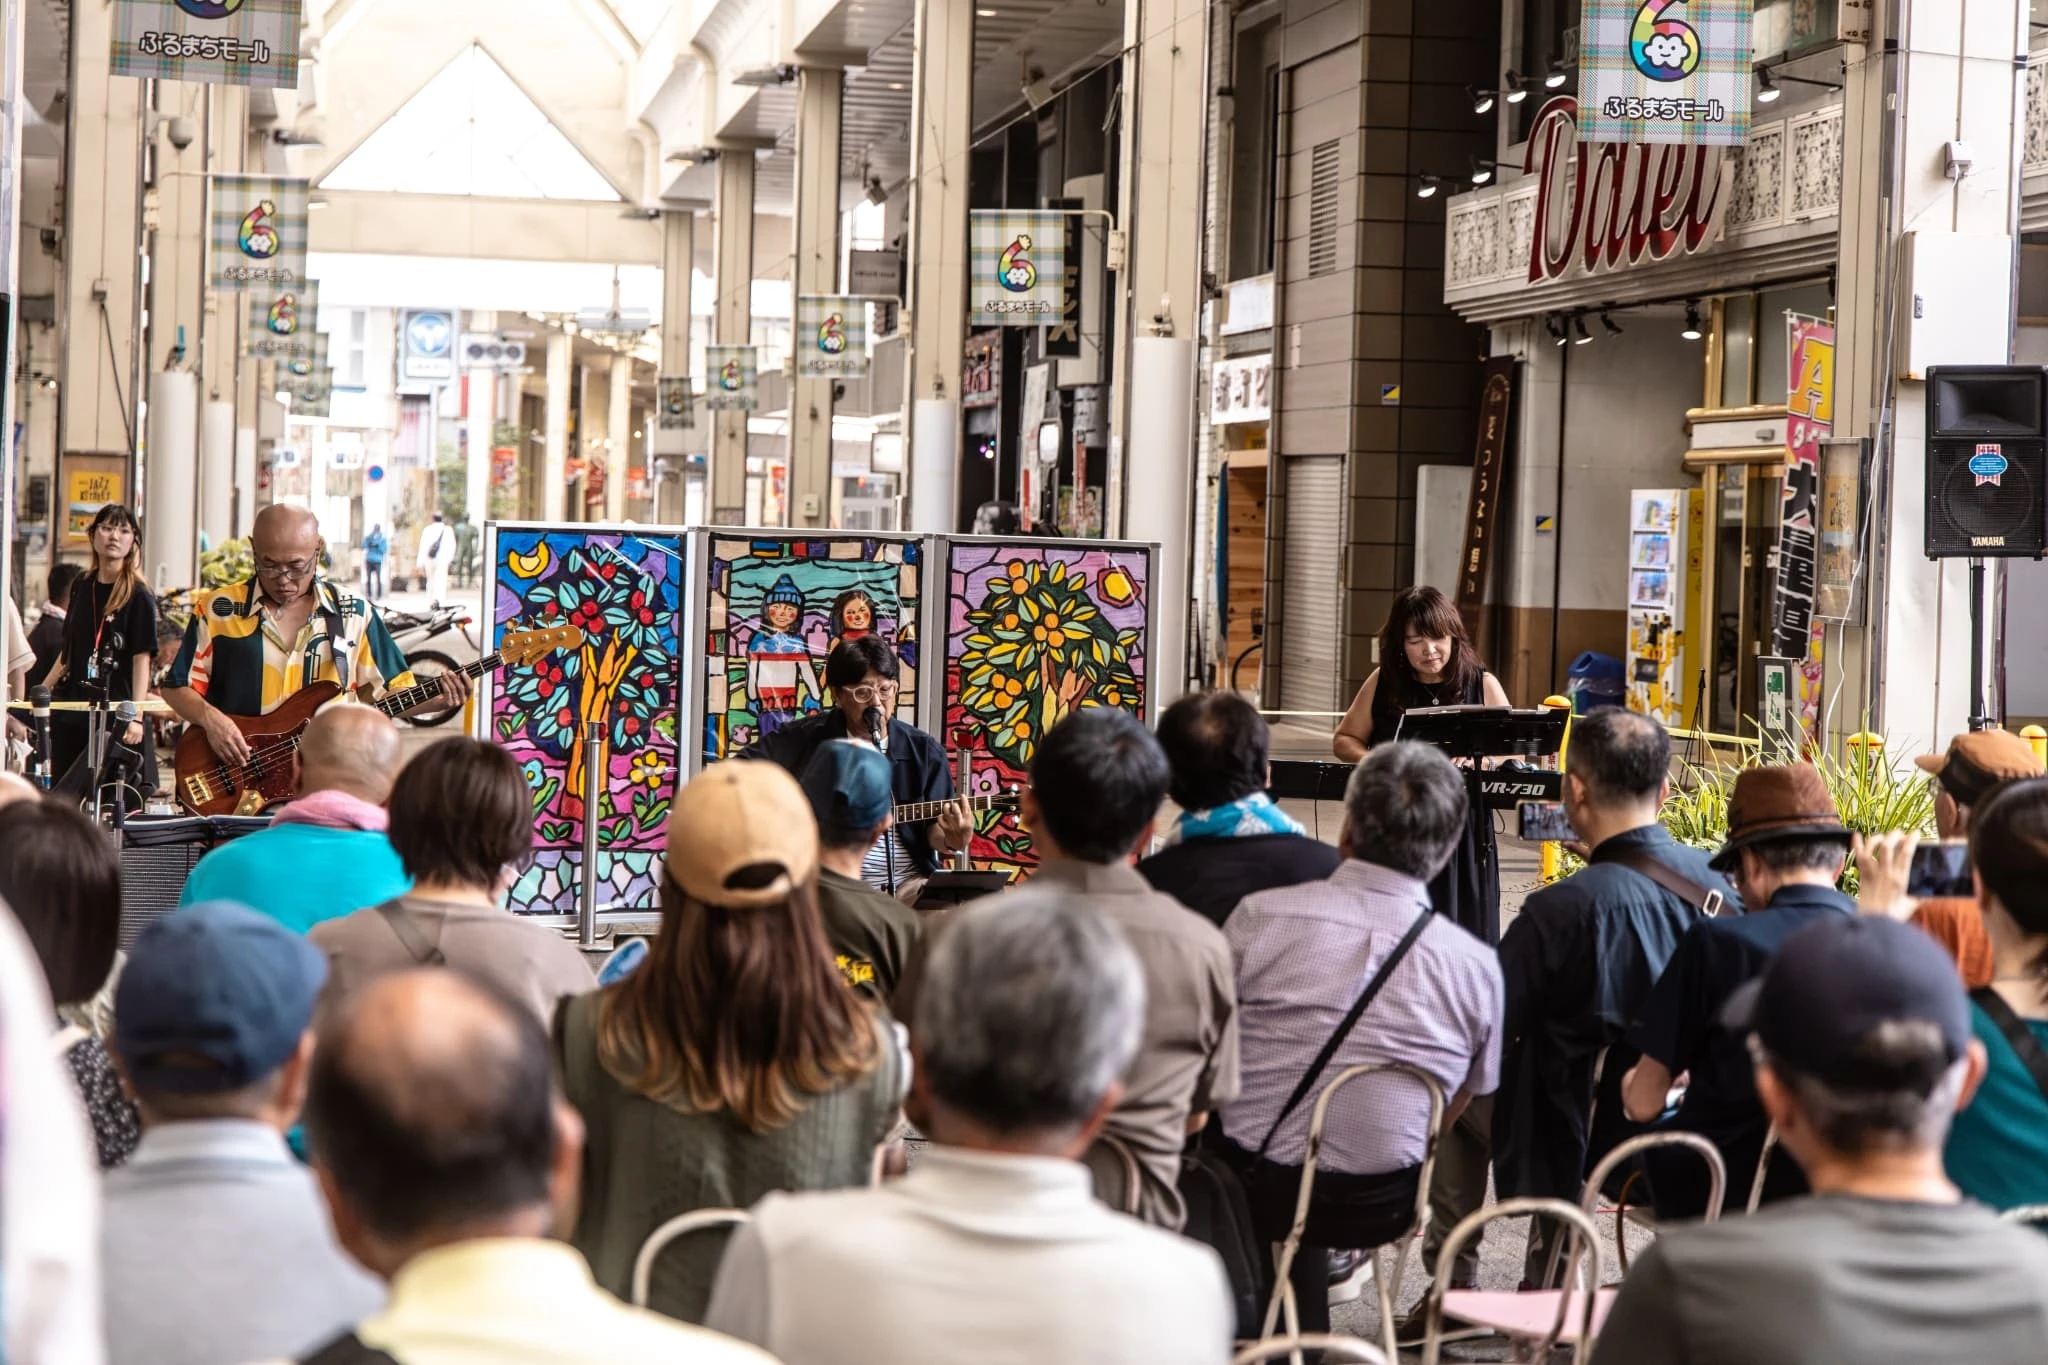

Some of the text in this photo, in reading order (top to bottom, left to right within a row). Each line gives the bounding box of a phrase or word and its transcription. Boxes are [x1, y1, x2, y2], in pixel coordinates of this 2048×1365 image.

[139, 32, 270, 63] ふるまちモール
[1604, 96, 1723, 122] ふるまちモール
[985, 301, 1050, 313] ふるまちモール
[1971, 536, 2005, 546] YAMAHA
[1481, 781, 1546, 796] VR-730
